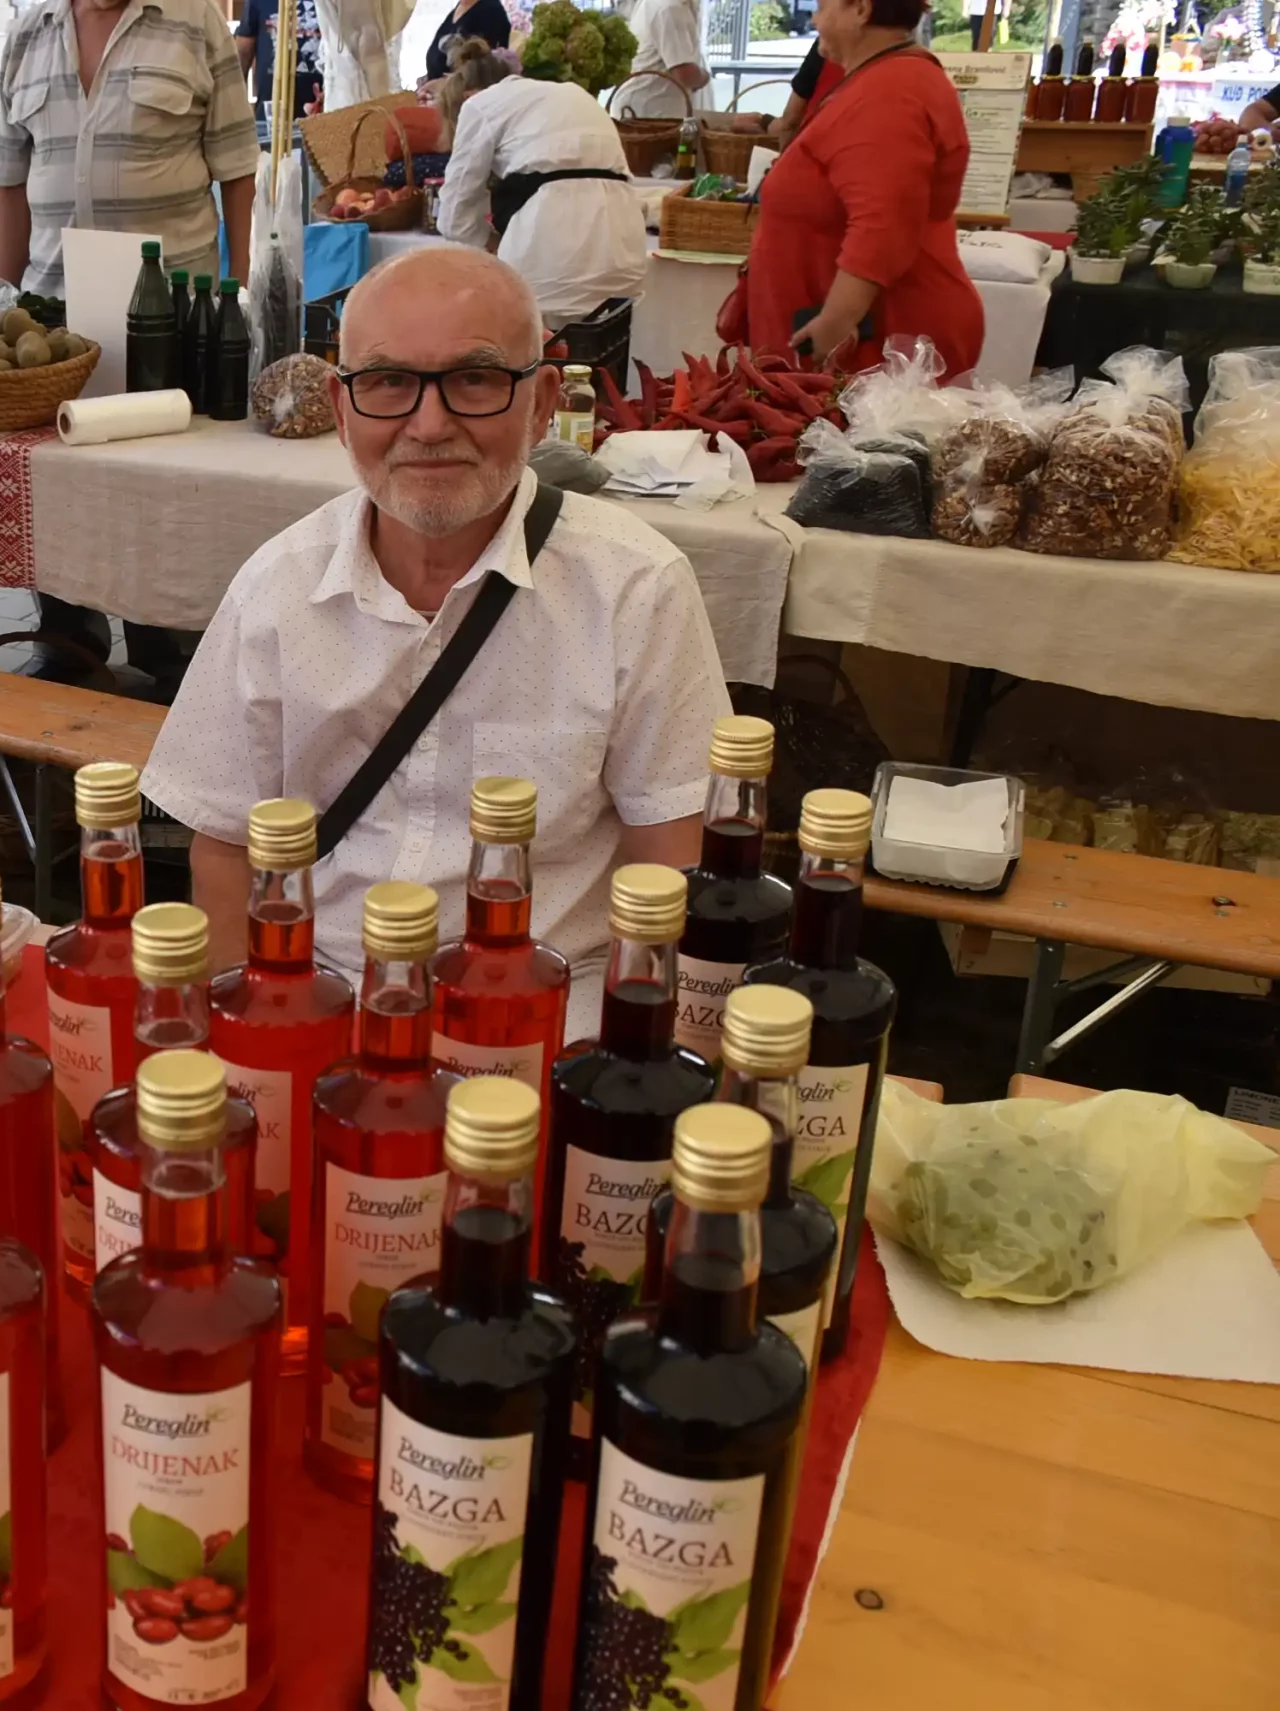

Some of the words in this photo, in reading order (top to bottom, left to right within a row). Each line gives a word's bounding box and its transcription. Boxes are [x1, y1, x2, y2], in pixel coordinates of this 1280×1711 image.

[105, 1195, 141, 1228] Pere
[345, 1190, 425, 1220] Pereglin
[122, 1403, 211, 1440] Pereglin
[112, 1434, 239, 1476] DRIJENAK
[398, 1435, 486, 1481] Pereglin
[390, 1464, 506, 1523] BAZGA
[618, 1479, 716, 1525] Pereglin
[608, 1508, 734, 1568] BAZGA
